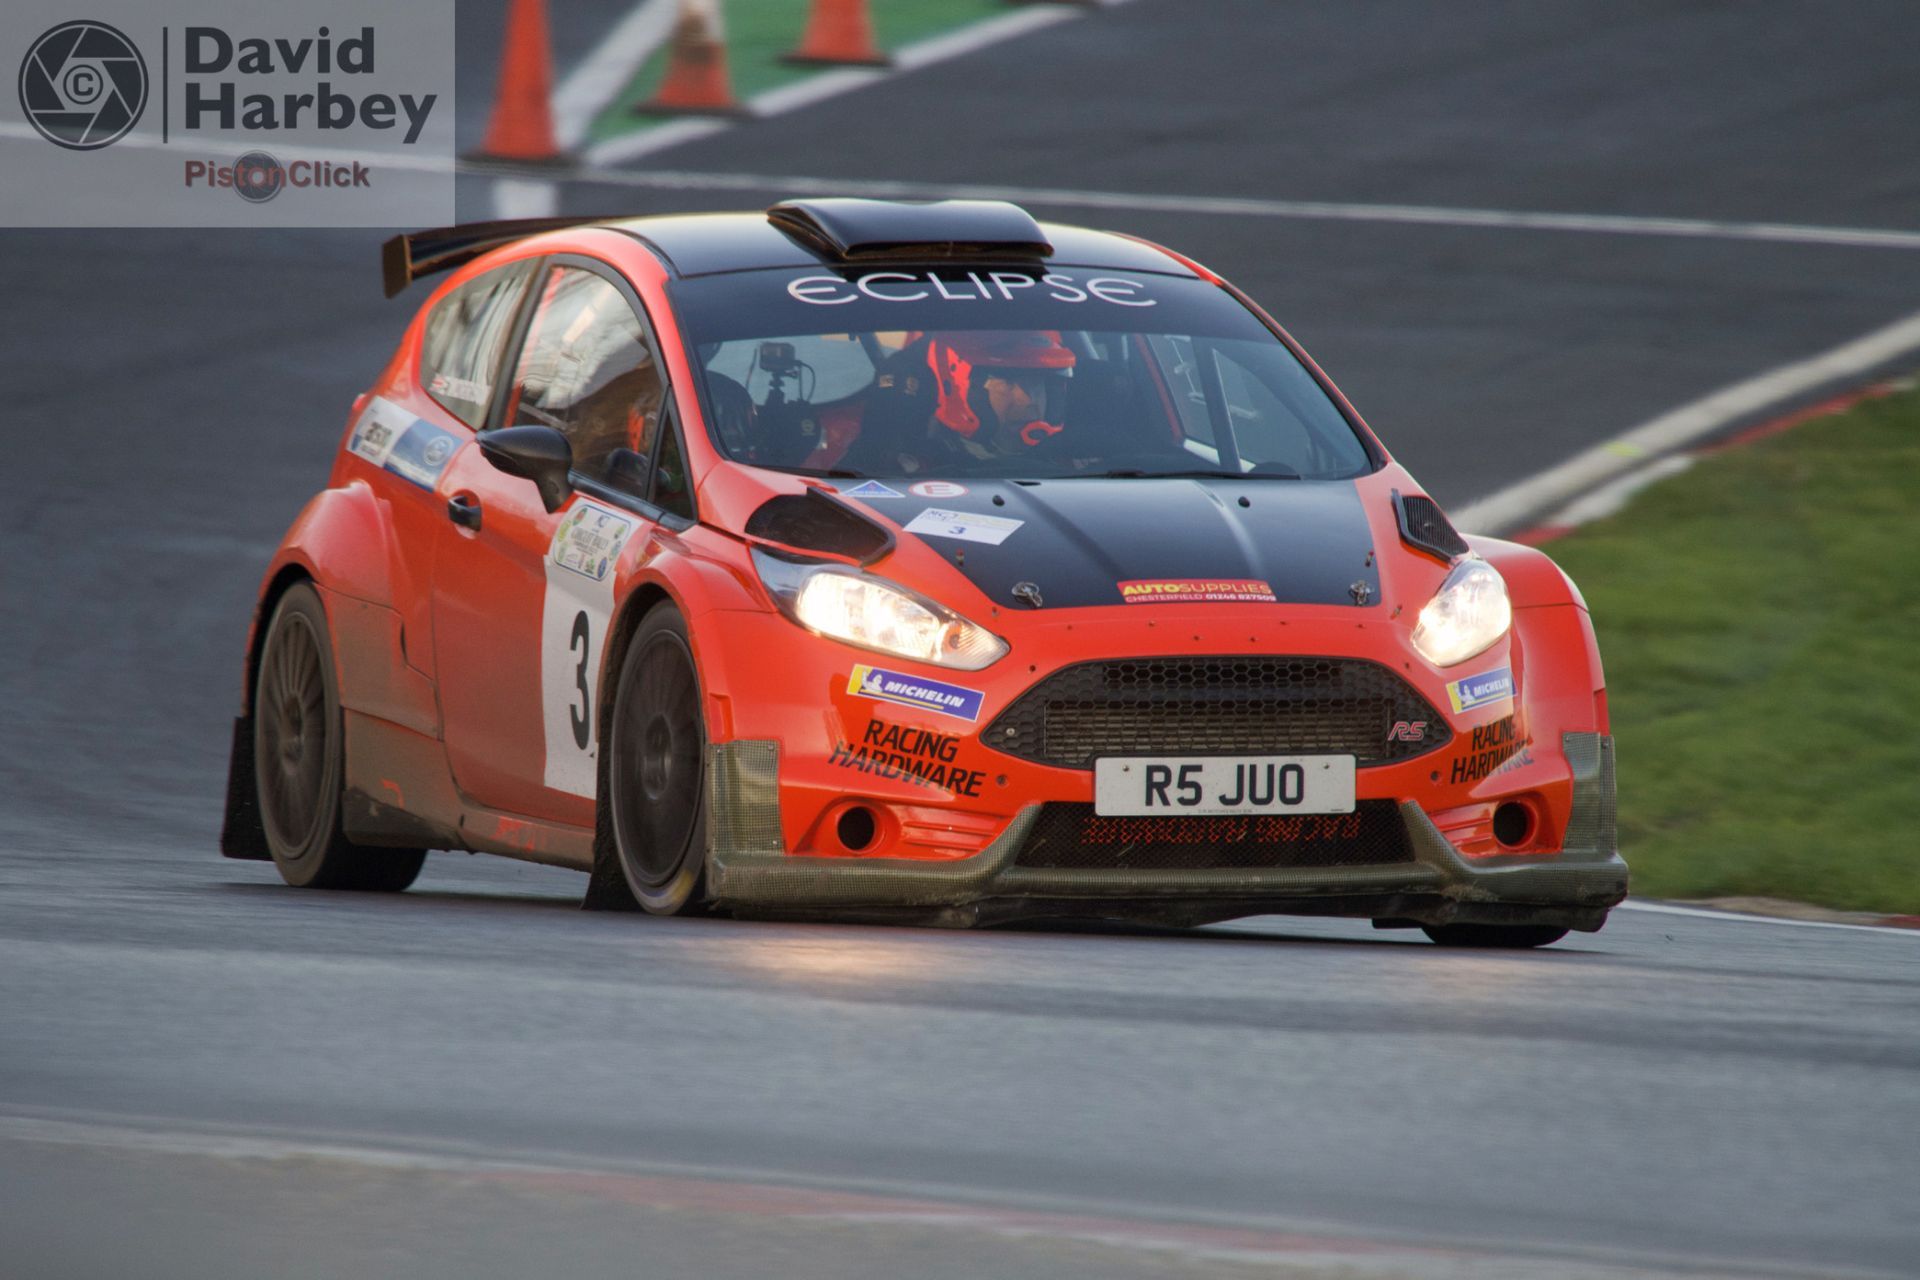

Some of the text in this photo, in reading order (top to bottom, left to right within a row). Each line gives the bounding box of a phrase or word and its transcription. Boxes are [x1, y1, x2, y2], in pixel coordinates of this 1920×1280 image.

[787, 271, 1157, 307] ECLIPSE
[1122, 583, 1273, 596] AUTOSUPPLIES
[1125, 593, 1203, 603] CHESTERFIELD
[570, 610, 591, 750] 3
[884, 681, 965, 708] MICHELIN
[1473, 678, 1510, 697] MICHELIN
[863, 719, 961, 763] RACING
[1387, 721, 1427, 741] RS
[828, 740, 987, 798] HARDWARE
[1145, 763, 1305, 807] R5 JUO
